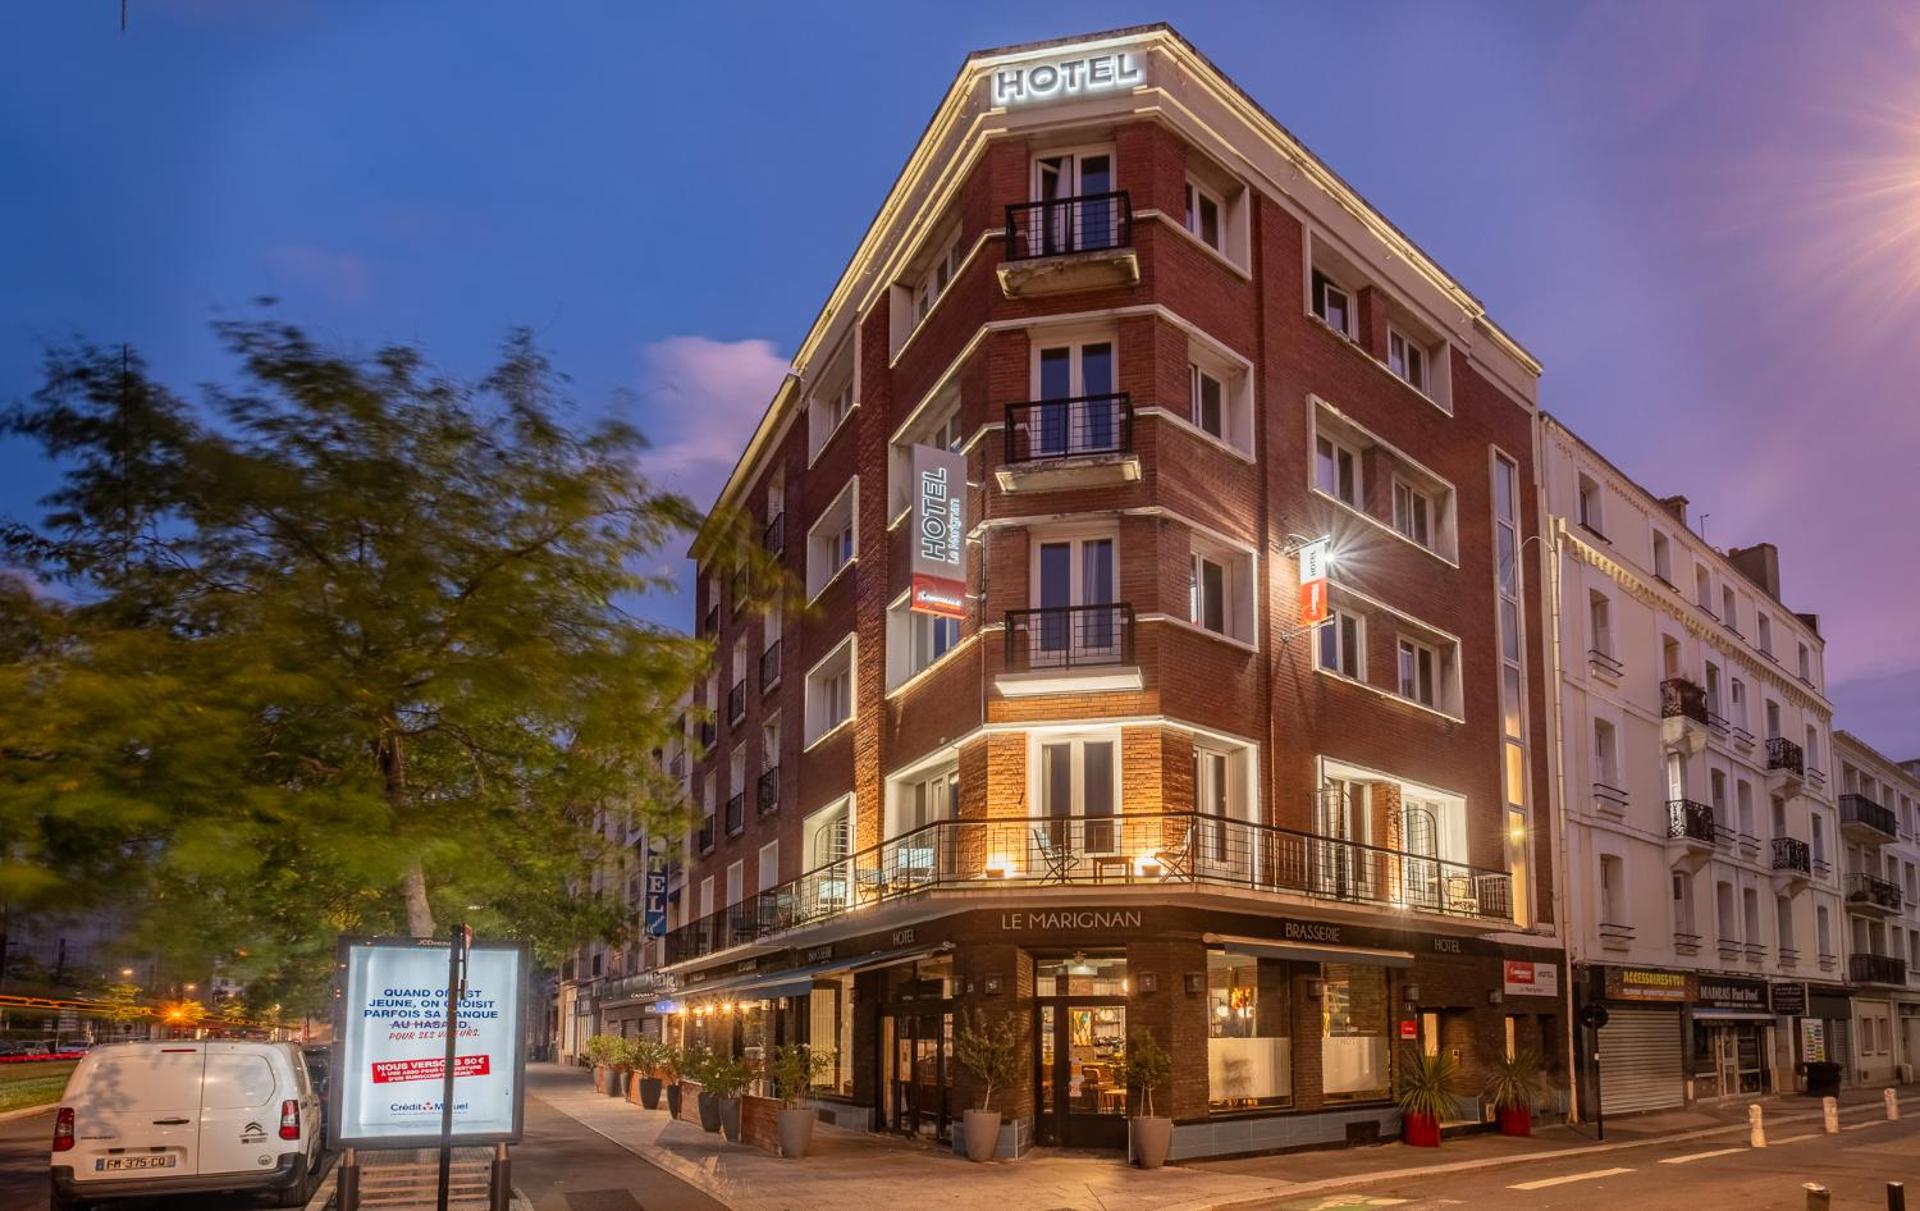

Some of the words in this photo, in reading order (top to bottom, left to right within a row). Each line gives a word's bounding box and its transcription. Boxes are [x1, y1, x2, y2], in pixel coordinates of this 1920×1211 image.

[997, 53, 1138, 98] HOTEL
[921, 467, 947, 562] HOTEL
[948, 498, 962, 550] Marignan
[948, 551, 960, 565] Le
[1002, 913, 1022, 929] LE
[1029, 911, 1141, 929] MARIGNAN
[892, 929, 915, 946] HOTEL
[1285, 923, 1341, 942] BRASSERIE
[1434, 938, 1461, 953] HOTEL
[384, 988, 431, 998] QUAND
[467, 989, 482, 998] ST
[368, 999, 417, 1009] JEUNE,
[421, 1000, 440, 1009] ON
[364, 1009, 420, 1019] PARFOIS
[424, 1010, 441, 1019] SA
[446, 1010, 498, 1019] ANQUE
[391, 1020, 410, 1029] AU
[414, 1020, 471, 1029] HASAD.
[388, 1031, 414, 1041] POUR
[418, 1031, 434, 1039] SES
[377, 1062, 408, 1071] NOUS
[411, 1059, 461, 1069] VERSOS
[464, 1057, 477, 1065] 50
[478, 1056, 485, 1064] €
[390, 1102, 421, 1111] Crédit
[434, 1102, 468, 1111] Muel
